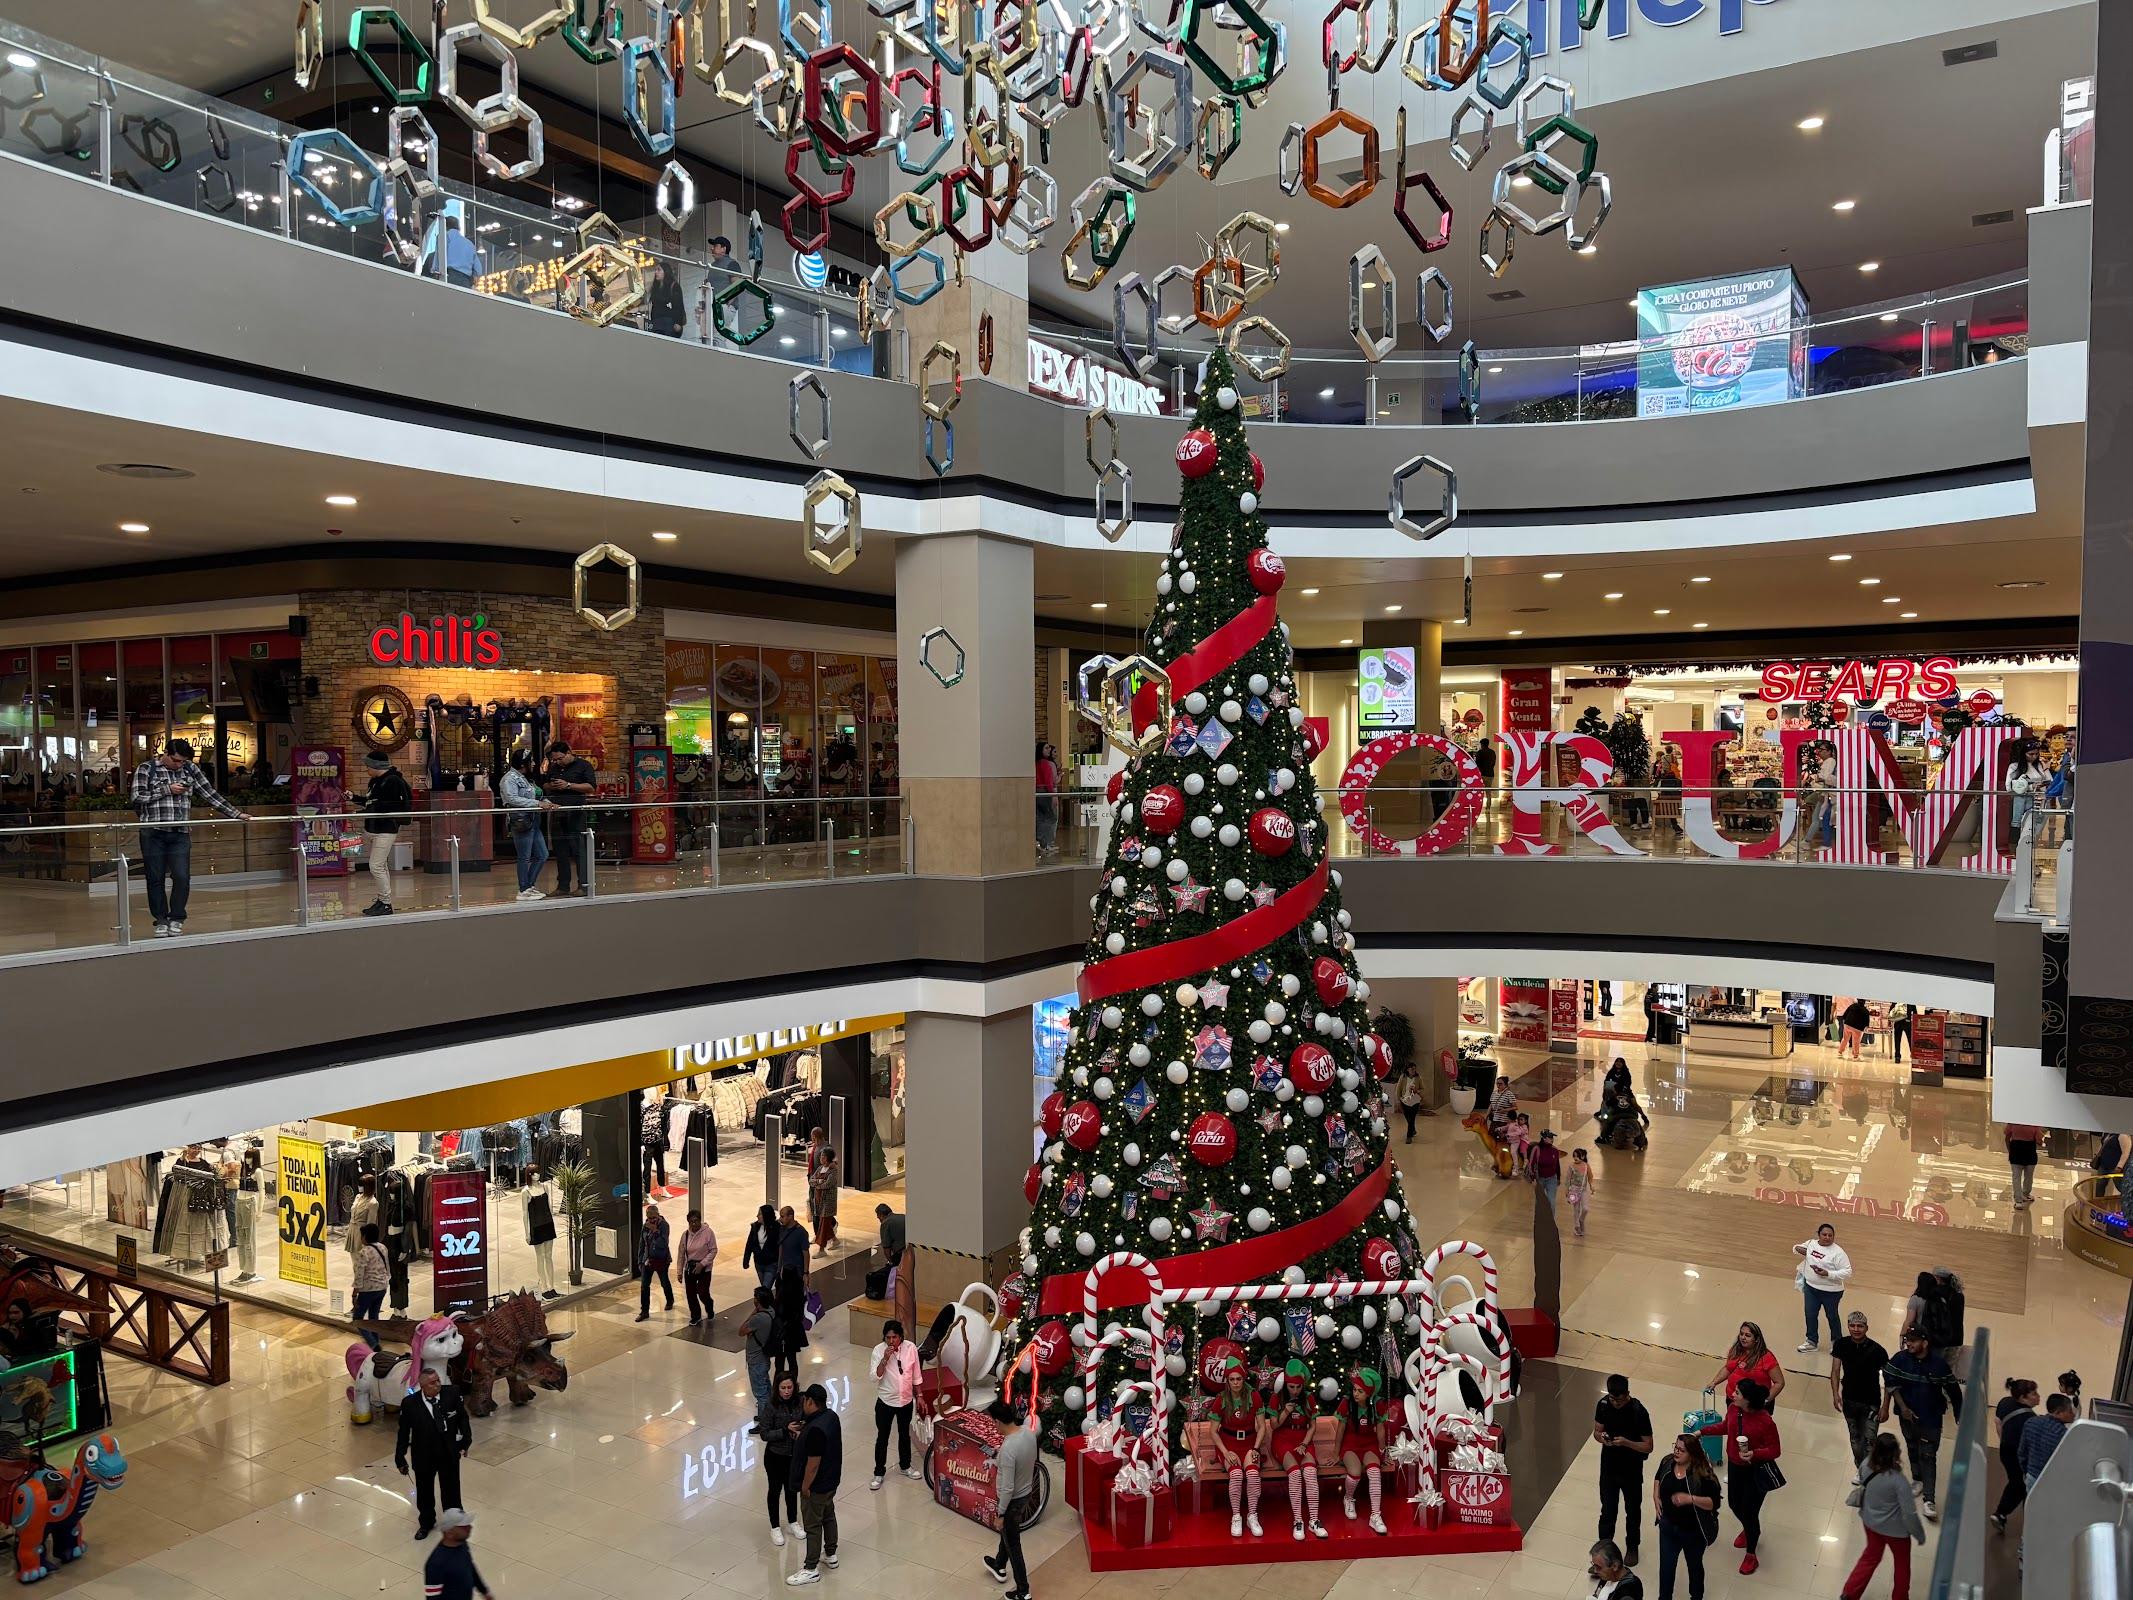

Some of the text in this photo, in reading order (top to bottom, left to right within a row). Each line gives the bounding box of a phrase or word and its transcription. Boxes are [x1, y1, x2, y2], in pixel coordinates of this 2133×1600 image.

[1680, 293, 1687, 302] Y
[1686, 286, 1730, 301] COMPARTE
[1731, 284, 1742, 294] TU
[1742, 279, 1775, 293] PROPIO
[1679, 301, 1710, 313] GLOBO
[1710, 299, 1721, 308] DE
[1106, 371, 1165, 415] RIBS
[371, 613, 501, 664] chili's
[1758, 656, 1959, 703] SEARS
[1510, 697, 1540, 708] Gran
[1509, 711, 1542, 722] Venta
[297, 766, 338, 777] JUEVES
[1303, 714, 2033, 875] ORUM
[1559, 1001, 1571, 1011] 50
[283, 1156, 321, 1179] TODA LA
[285, 1174, 319, 1196] TIENDA
[278, 1195, 326, 1251] 3x2
[440, 1230, 481, 1258] 3x2
[946, 1459, 991, 1484] Navidad
[1455, 1474, 1501, 1505] KitKat
[1460, 1507, 1493, 1518] MAXIMO
[1473, 1516, 1493, 1525] KILOS
